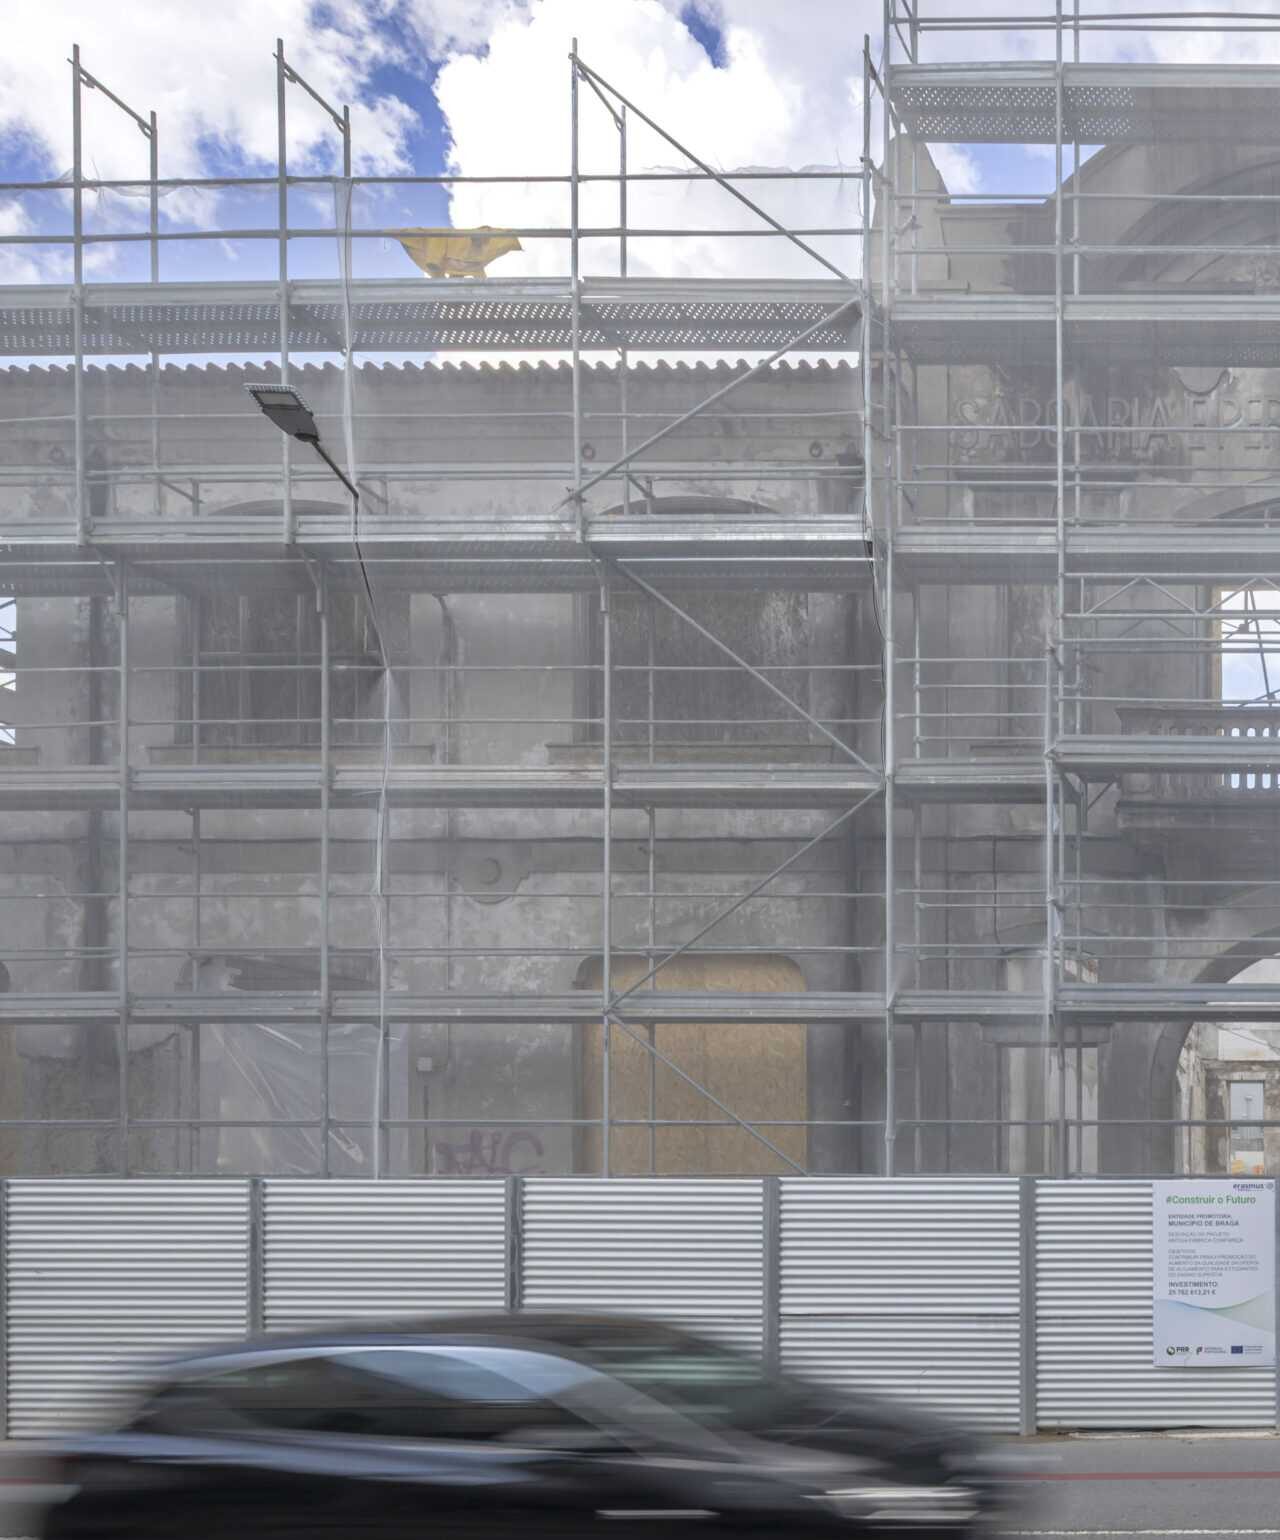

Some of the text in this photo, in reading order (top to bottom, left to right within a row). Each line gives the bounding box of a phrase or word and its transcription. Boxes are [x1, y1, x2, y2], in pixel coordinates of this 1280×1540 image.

[1166, 1195, 1256, 1205] #Construir o Futuro
